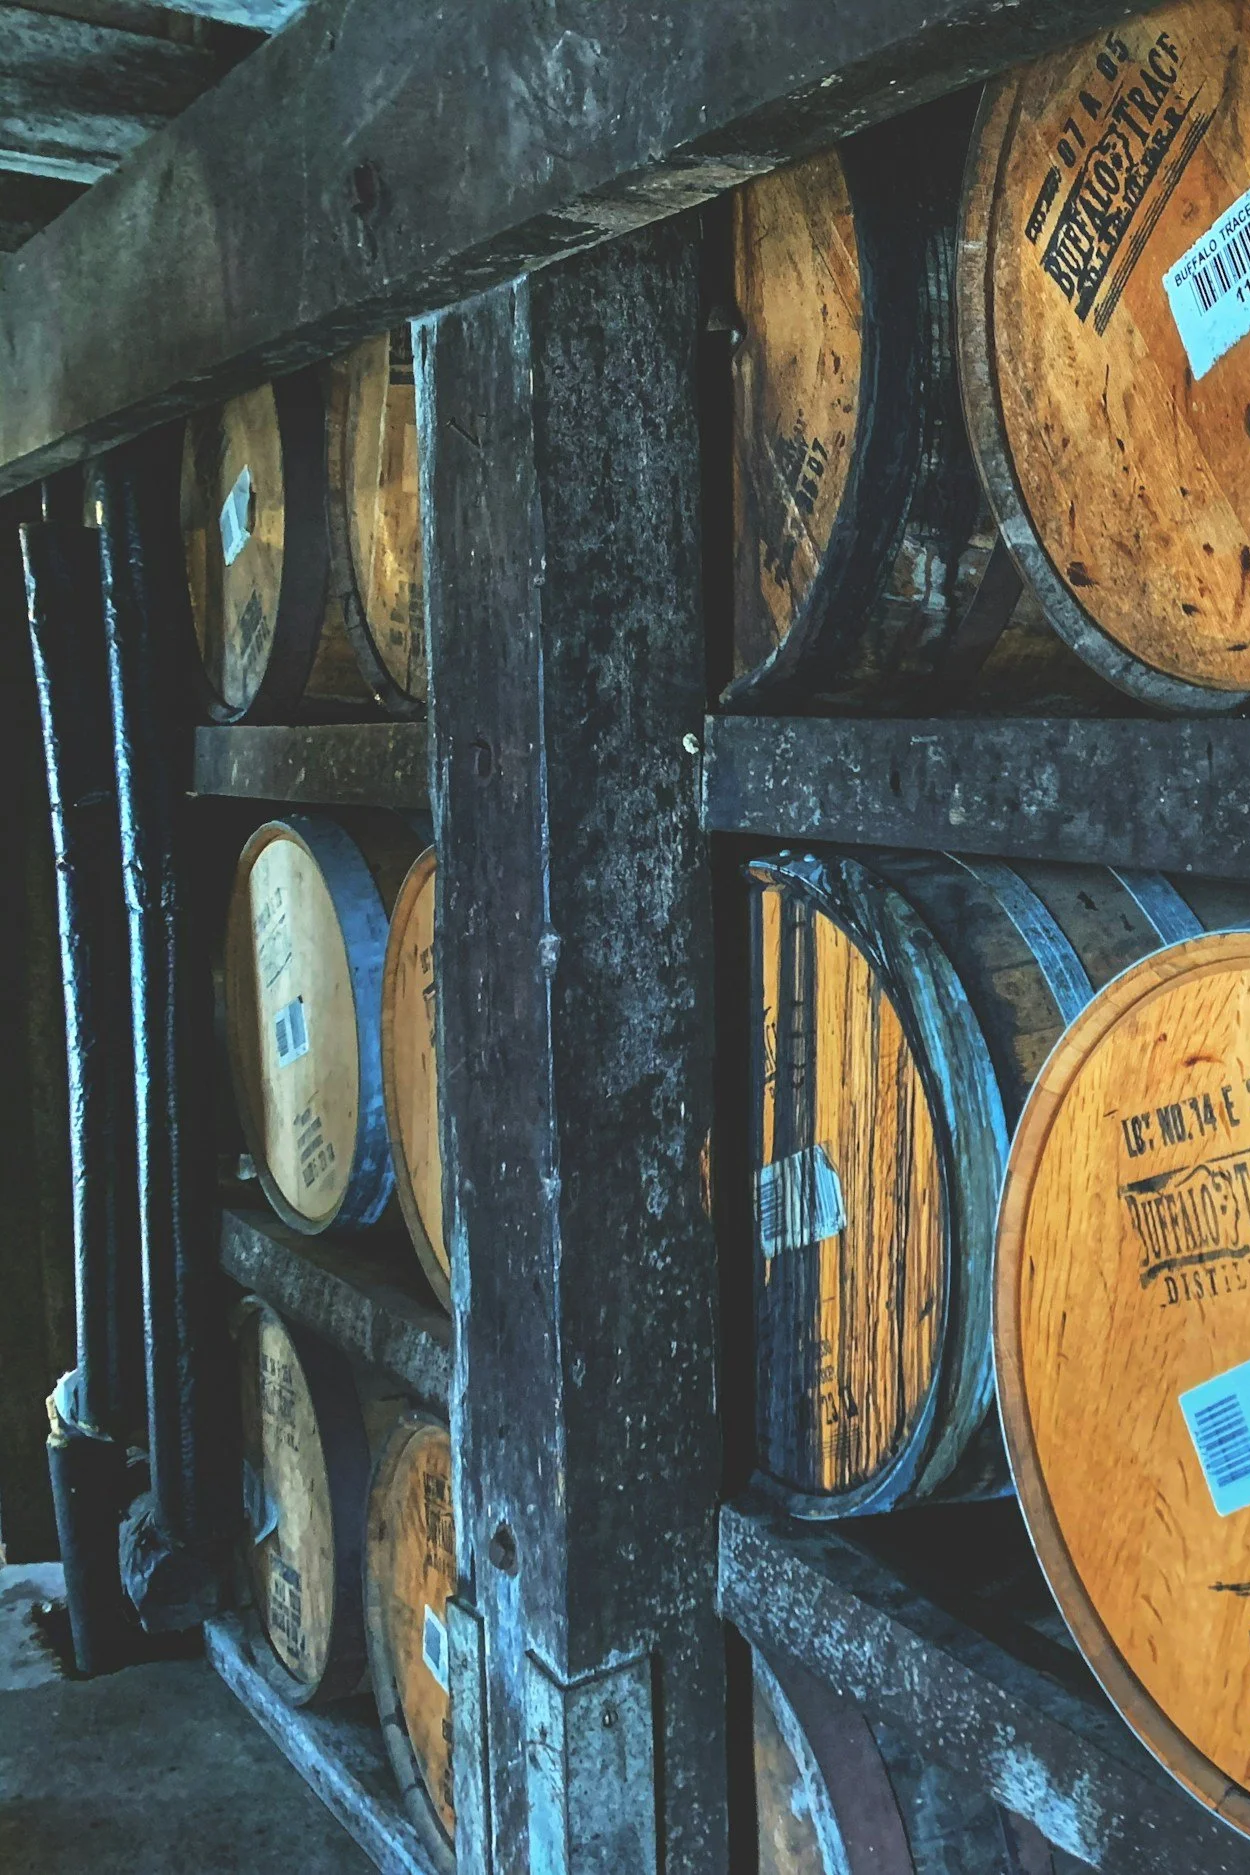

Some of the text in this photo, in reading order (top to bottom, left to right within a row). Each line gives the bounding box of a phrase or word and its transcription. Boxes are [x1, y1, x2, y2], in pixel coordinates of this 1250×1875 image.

[1044, 155, 1122, 304] BUFFALO
[1174, 239, 1218, 287] BUFFALO
[1221, 1084, 1240, 1127] E
[1125, 1182, 1221, 1267] BUFFALO
